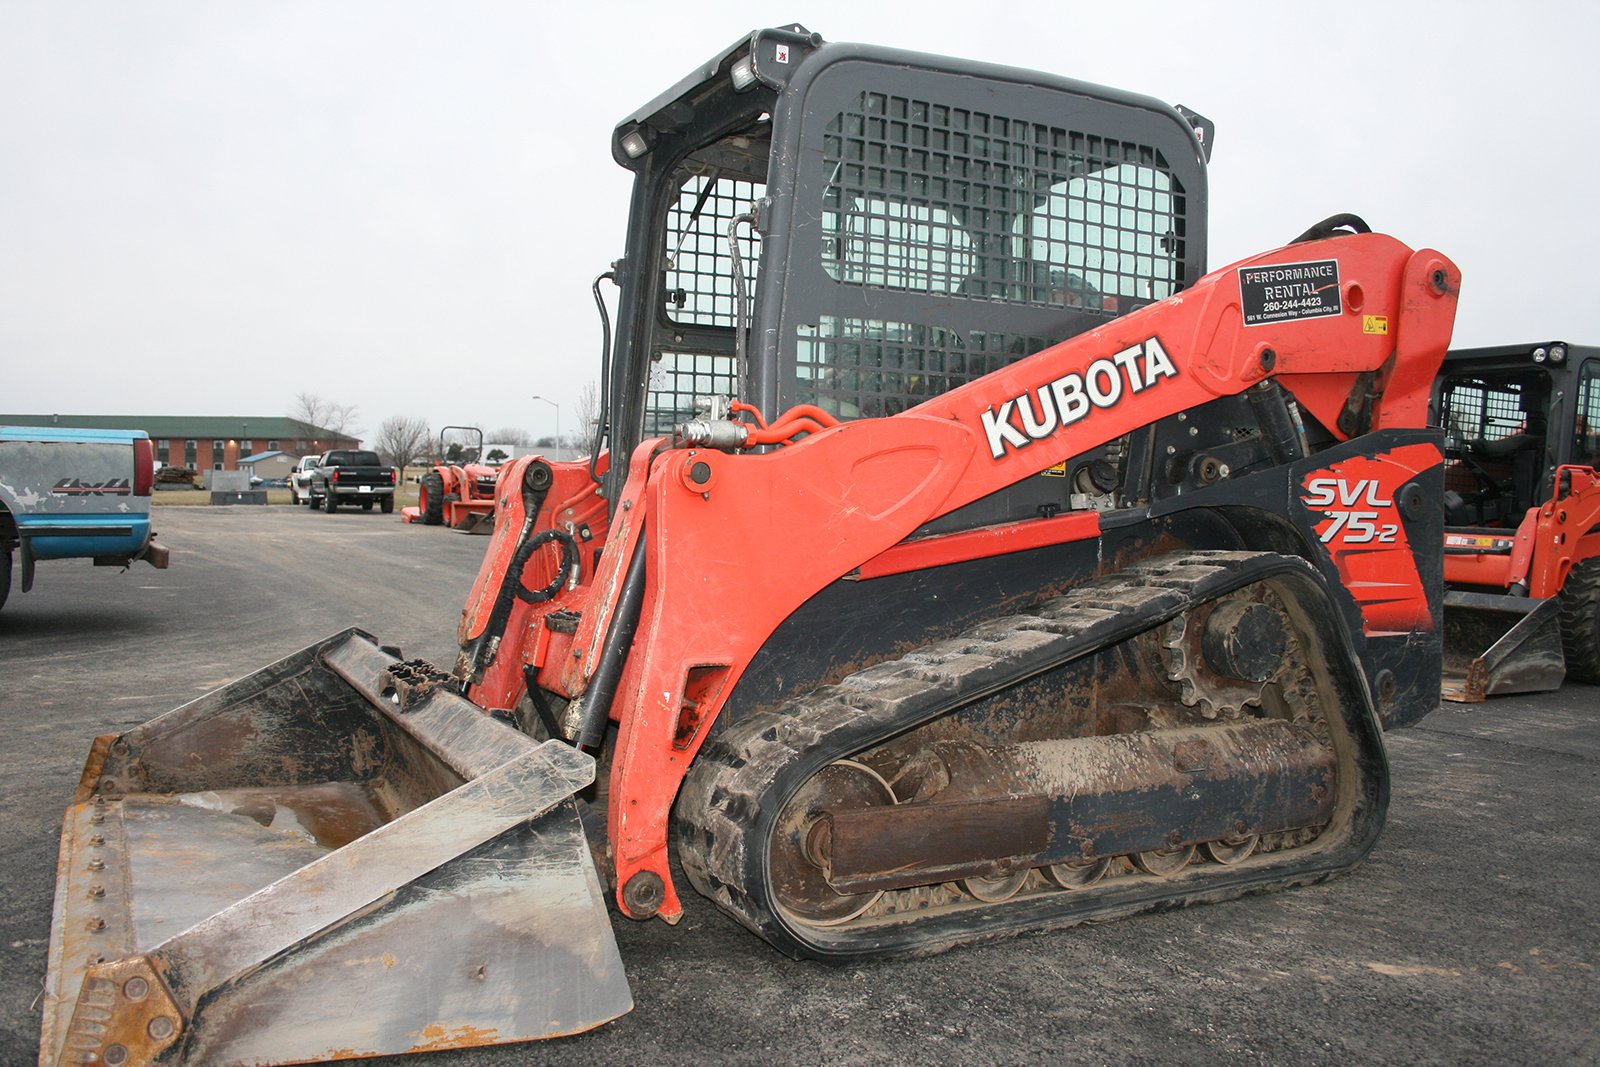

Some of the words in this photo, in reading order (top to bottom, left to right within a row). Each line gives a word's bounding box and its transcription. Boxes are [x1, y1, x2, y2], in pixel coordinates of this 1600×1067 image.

[1245, 266, 1333, 284] PERFORMANCE
[1264, 283, 1319, 300] RENTAL
[1263, 297, 1322, 312] 260-244-4423
[1301, 307, 1323, 315] Columbia
[980, 336, 1178, 459] KUBOTA
[1304, 478, 1392, 507] SVL
[1319, 511, 1398, 543] 75-2
